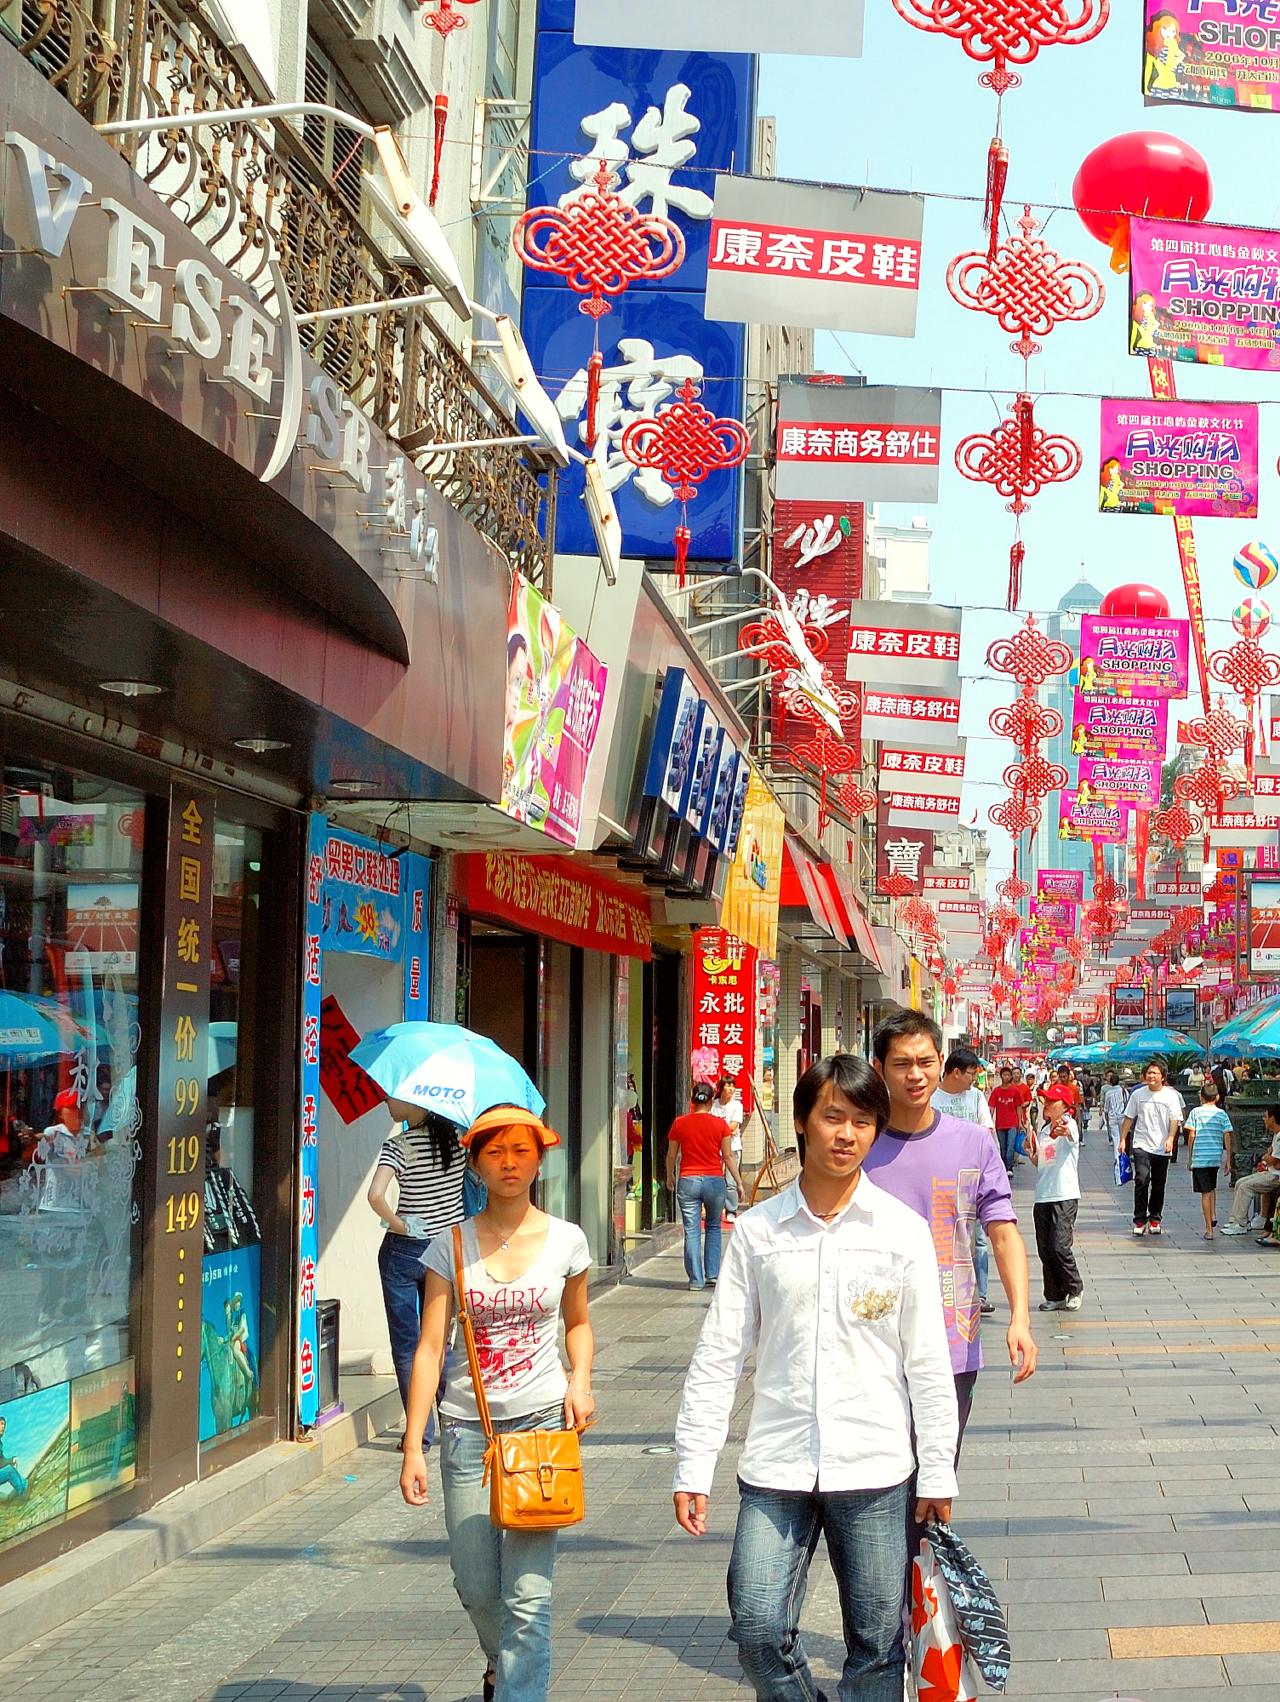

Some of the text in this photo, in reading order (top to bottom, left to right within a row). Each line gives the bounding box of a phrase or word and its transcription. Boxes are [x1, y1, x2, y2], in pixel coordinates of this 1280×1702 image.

[711, 226, 917, 284] 康奈皮鞋
[781, 426, 936, 460] 康奈商务舒仕
[1125, 429, 1241, 462] 月光购物
[1132, 461, 1234, 479] SHOPPING
[850, 630, 959, 658] 康奈皮鞋
[1098, 636, 1177, 660] 月光购物
[1102, 659, 1173, 673] SHOPPING
[865, 695, 958, 719] 康奈商务舒仕
[1088, 705, 1157, 727] 月光购物
[1092, 725, 1152, 737] SHOPPING
[881, 752, 964, 776] 康奈皮鞋
[1095, 780, 1148, 790] SHOPPING
[891, 794, 959, 812] 康奈商务舒仕
[324, 837, 400, 897] 贸男女鞋处理
[166, 799, 203, 1233] 全国统一价 99 119 149
[413, 1084, 466, 1100] MOTO
[931, 1177, 957, 1266] AIRPORT
